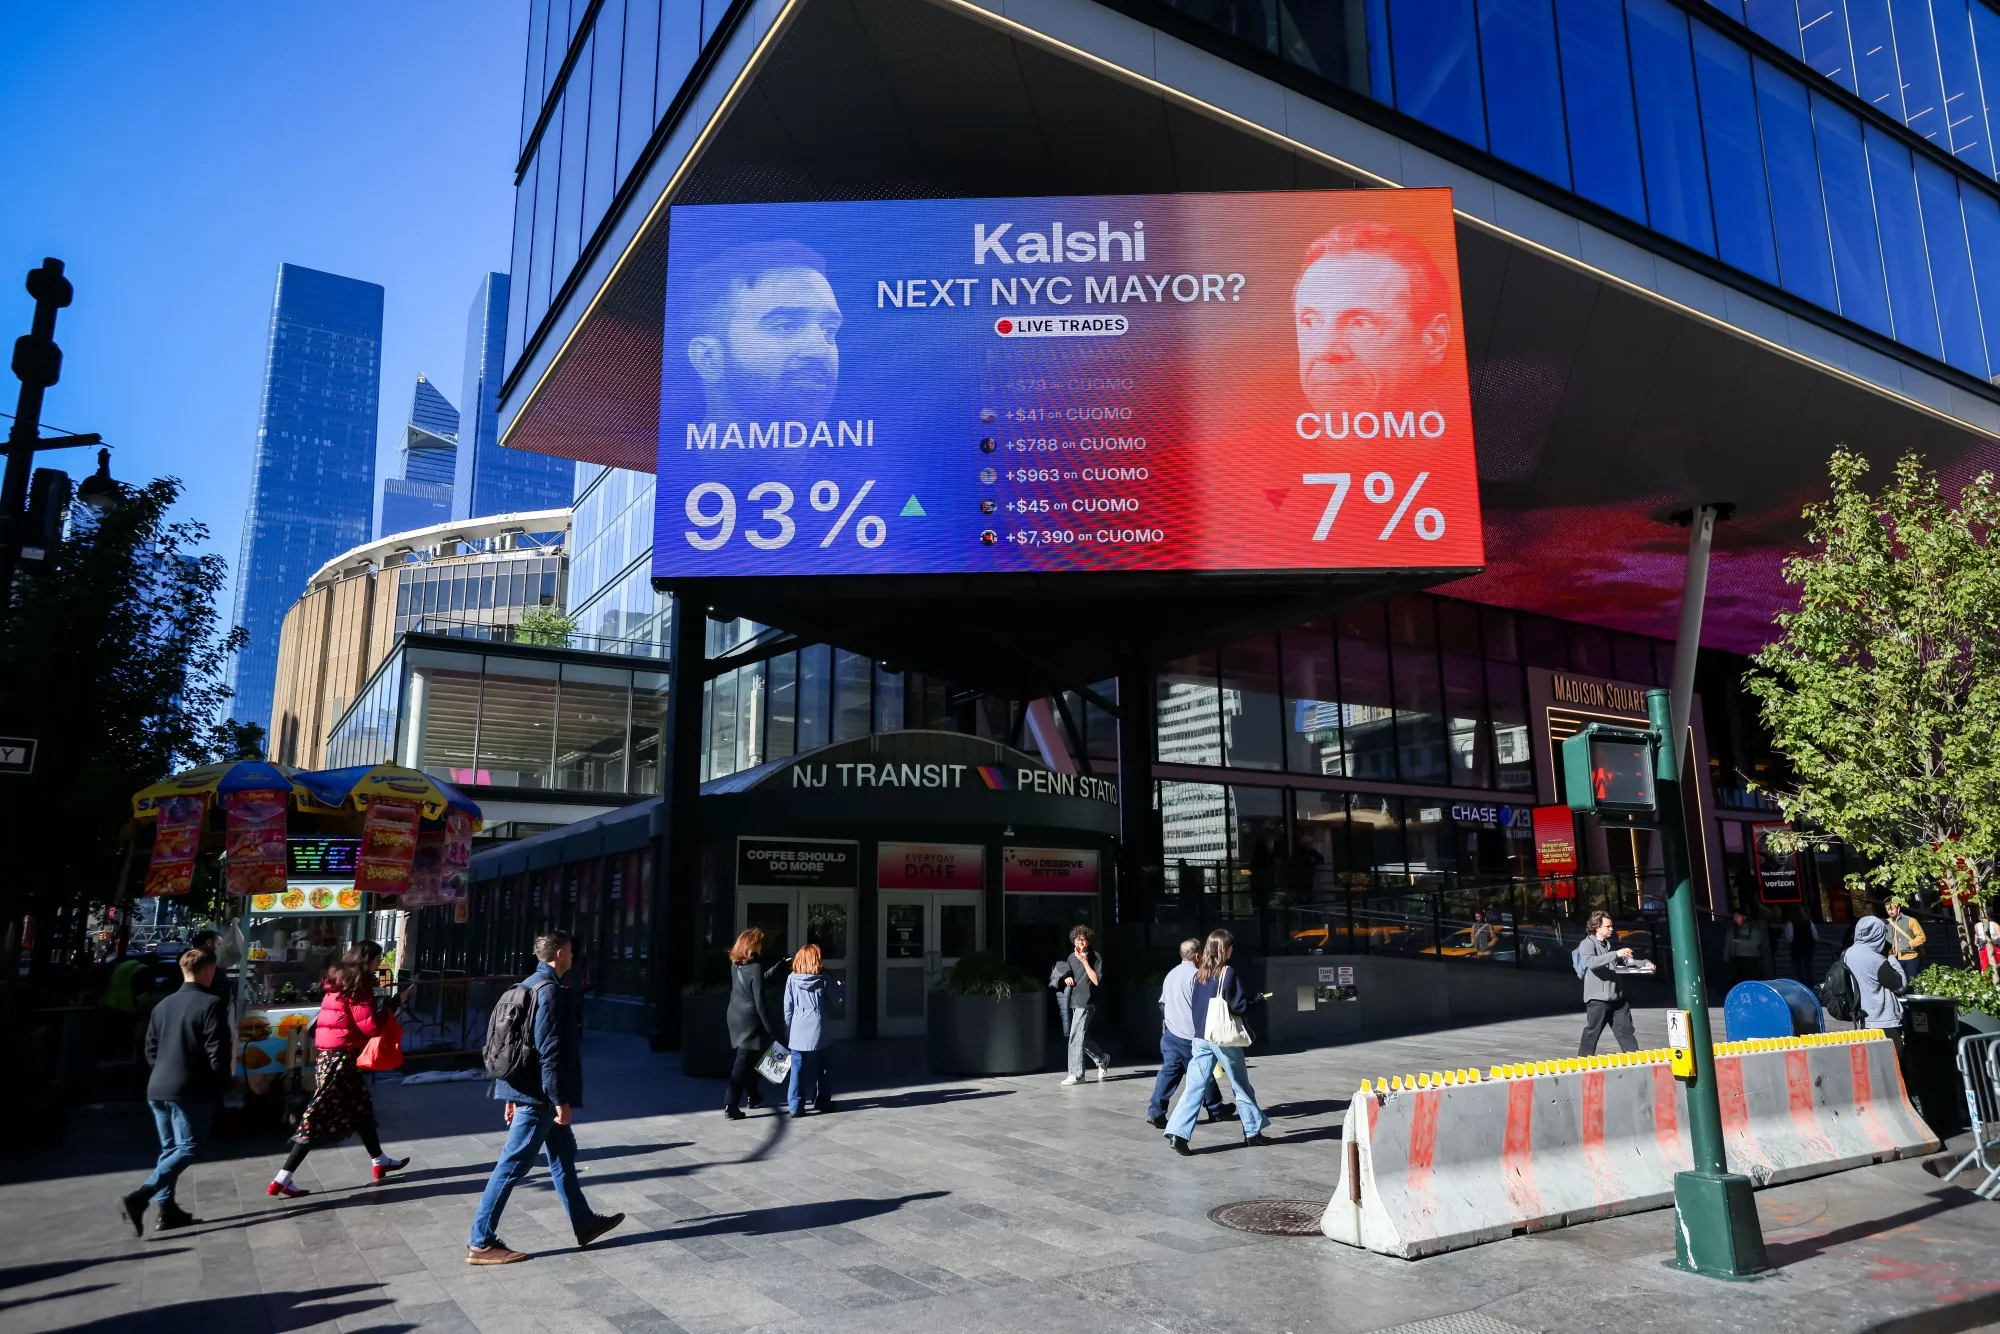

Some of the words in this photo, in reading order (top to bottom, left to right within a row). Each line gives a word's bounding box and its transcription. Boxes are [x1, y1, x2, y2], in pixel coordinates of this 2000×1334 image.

[974, 221, 1145, 264] Kalshi
[877, 278, 979, 308] NEXT
[991, 276, 1073, 306] NYC
[1085, 273, 1246, 304] MAYOR?
[1018, 320, 1054, 333] LIVE
[1059, 318, 1125, 332] TRADES
[1068, 377, 1134, 391] CUOMO
[1006, 407, 1044, 423] +$41
[1048, 410, 1062, 420] on
[1066, 407, 1132, 421] CUOMO
[1296, 410, 1446, 440] CUOMO
[685, 420, 874, 450] MAMDANI
[1006, 438, 1058, 453] +$788
[1062, 440, 1076, 450] on
[1080, 437, 1147, 451] CUOMO
[1006, 468, 1060, 483] +$963
[1063, 471, 1078, 480] on
[1082, 467, 1149, 481] CUOMO
[1006, 498, 1050, 514] +$45
[1053, 502, 1068, 511] on
[1072, 498, 1139, 512] CUOMO
[1302, 471, 1446, 541] 7%
[684, 480, 887, 552] 93%
[1006, 529, 1074, 547] +$7,390
[1078, 532, 1092, 542] on
[1096, 529, 1164, 543] CUOMO
[1553, 675, 1604, 707] MADISON
[1605, 683, 1647, 713] SQUARE
[792, 764, 828, 788] NJ
[836, 763, 967, 788] TRANSIT
[1017, 768, 1075, 796] PENN
[1080, 775, 1118, 805] STATIO
[1451, 805, 1498, 822] CHASE
[747, 850, 797, 861] COFFEE
[797, 851, 847, 863] SHOULD
[905, 853, 955, 862] EVERYDAY
[1018, 859, 1038, 868] YOU
[1039, 859, 1084, 869] DESERVE
[769, 861, 788, 871] DO
[789, 862, 825, 872] MORE
[1031, 868, 1070, 877] BETTER
